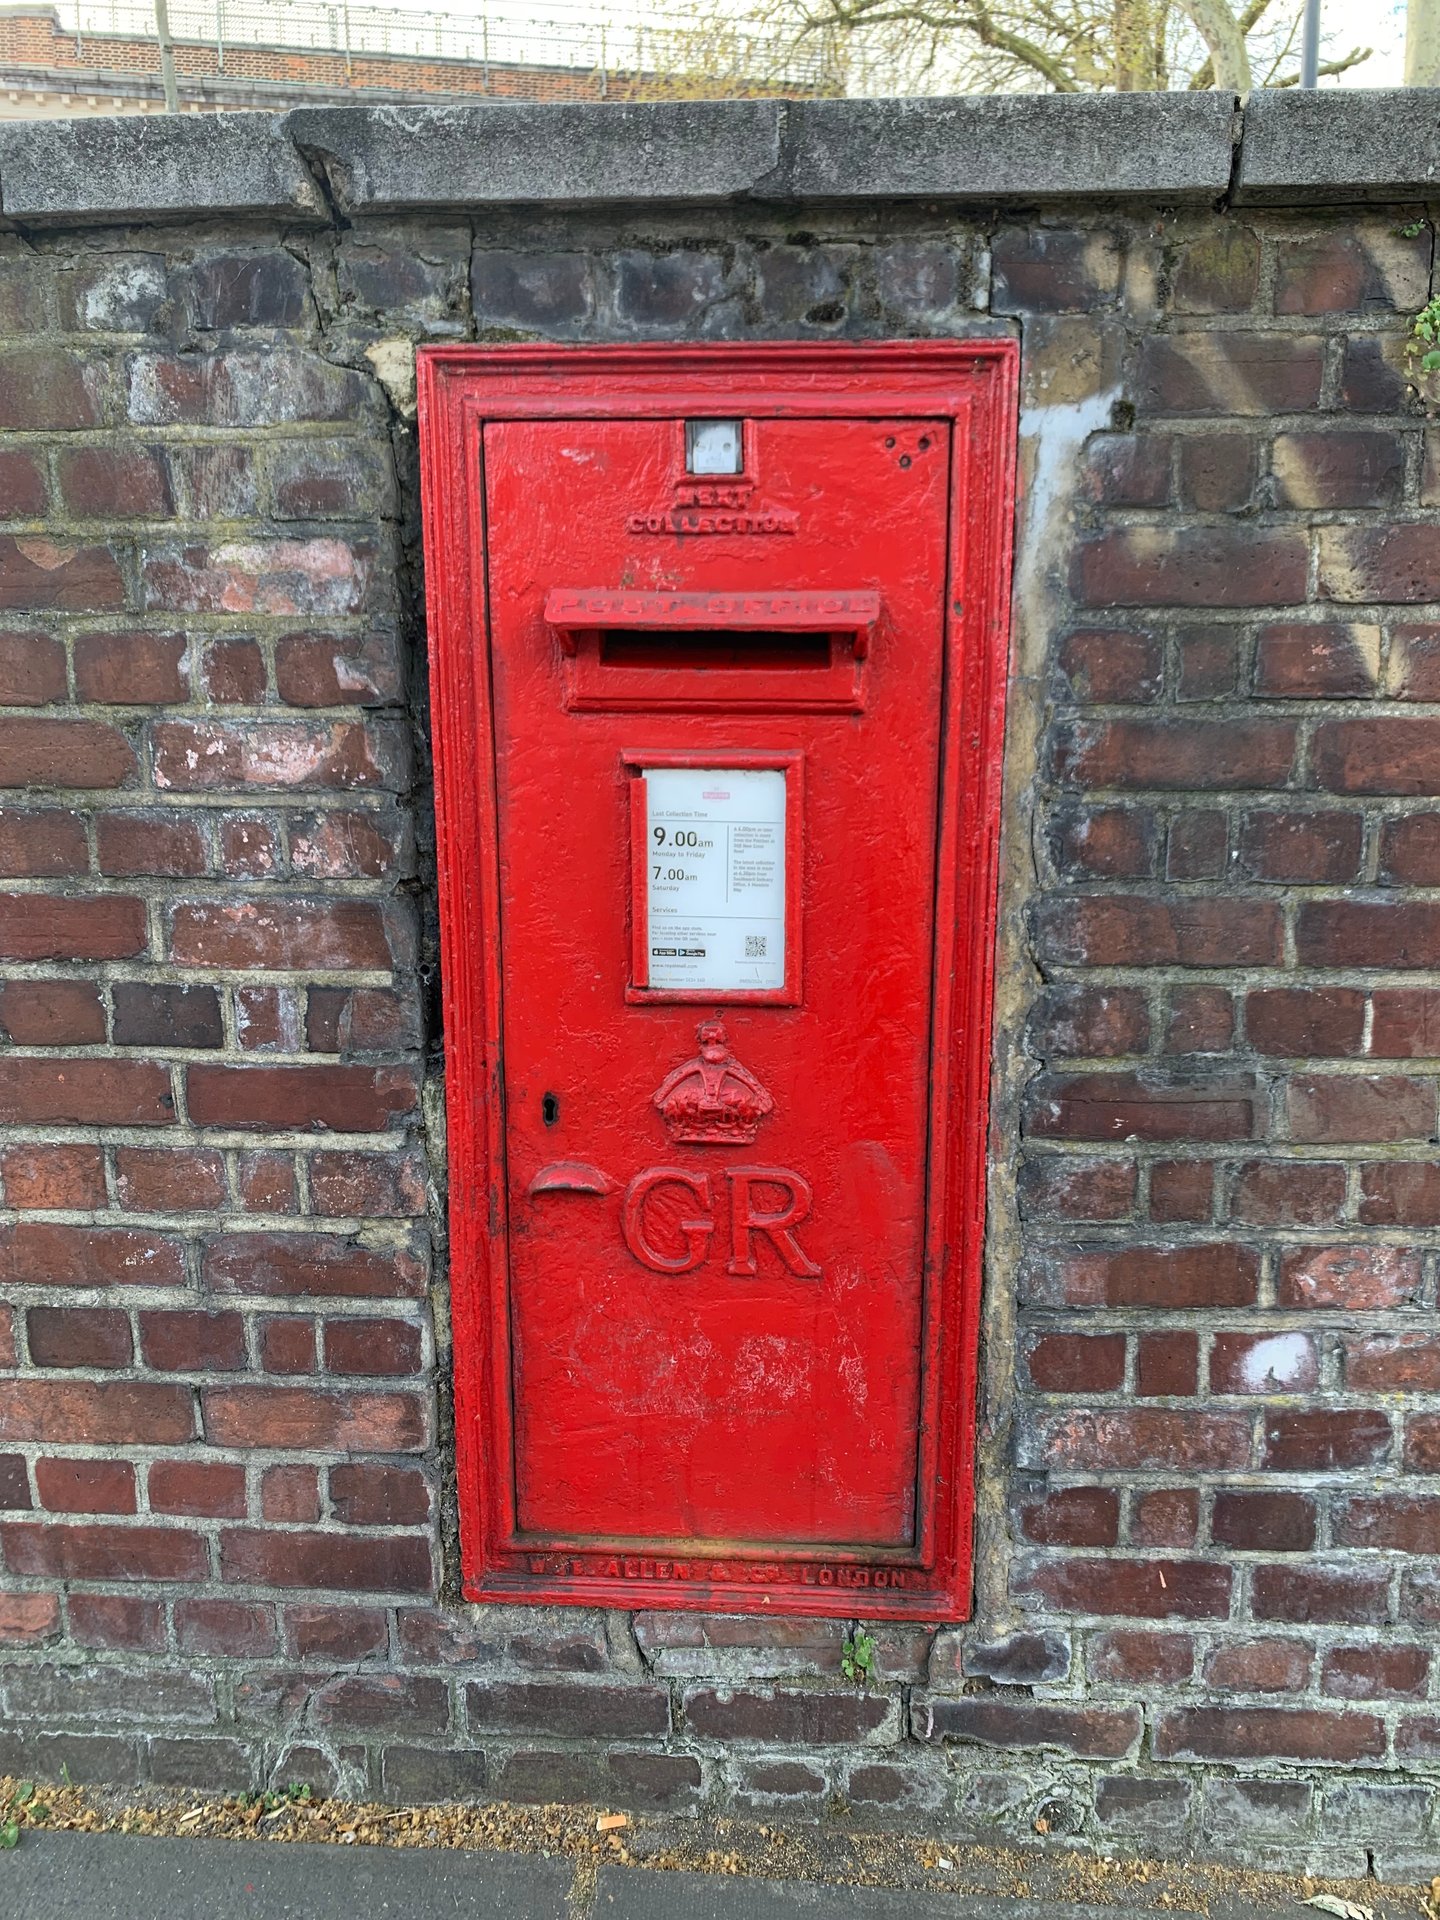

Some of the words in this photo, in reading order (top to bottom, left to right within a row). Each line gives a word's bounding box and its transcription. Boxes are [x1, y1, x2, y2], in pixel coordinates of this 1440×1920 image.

[675, 486, 753, 507] NEXT
[628, 513, 798, 535] COLLECTION
[552, 594, 680, 614] POST
[707, 597, 875, 614] OFFICE
[654, 827, 713, 847] 9.00am
[653, 851, 676, 859] Monday
[687, 851, 705, 859] Friday
[653, 867, 697, 880] 7.00am
[622, 1165, 823, 1278] GR
[606, 1560, 689, 1579] ALLEN
[801, 1568, 906, 1588] LONDON
